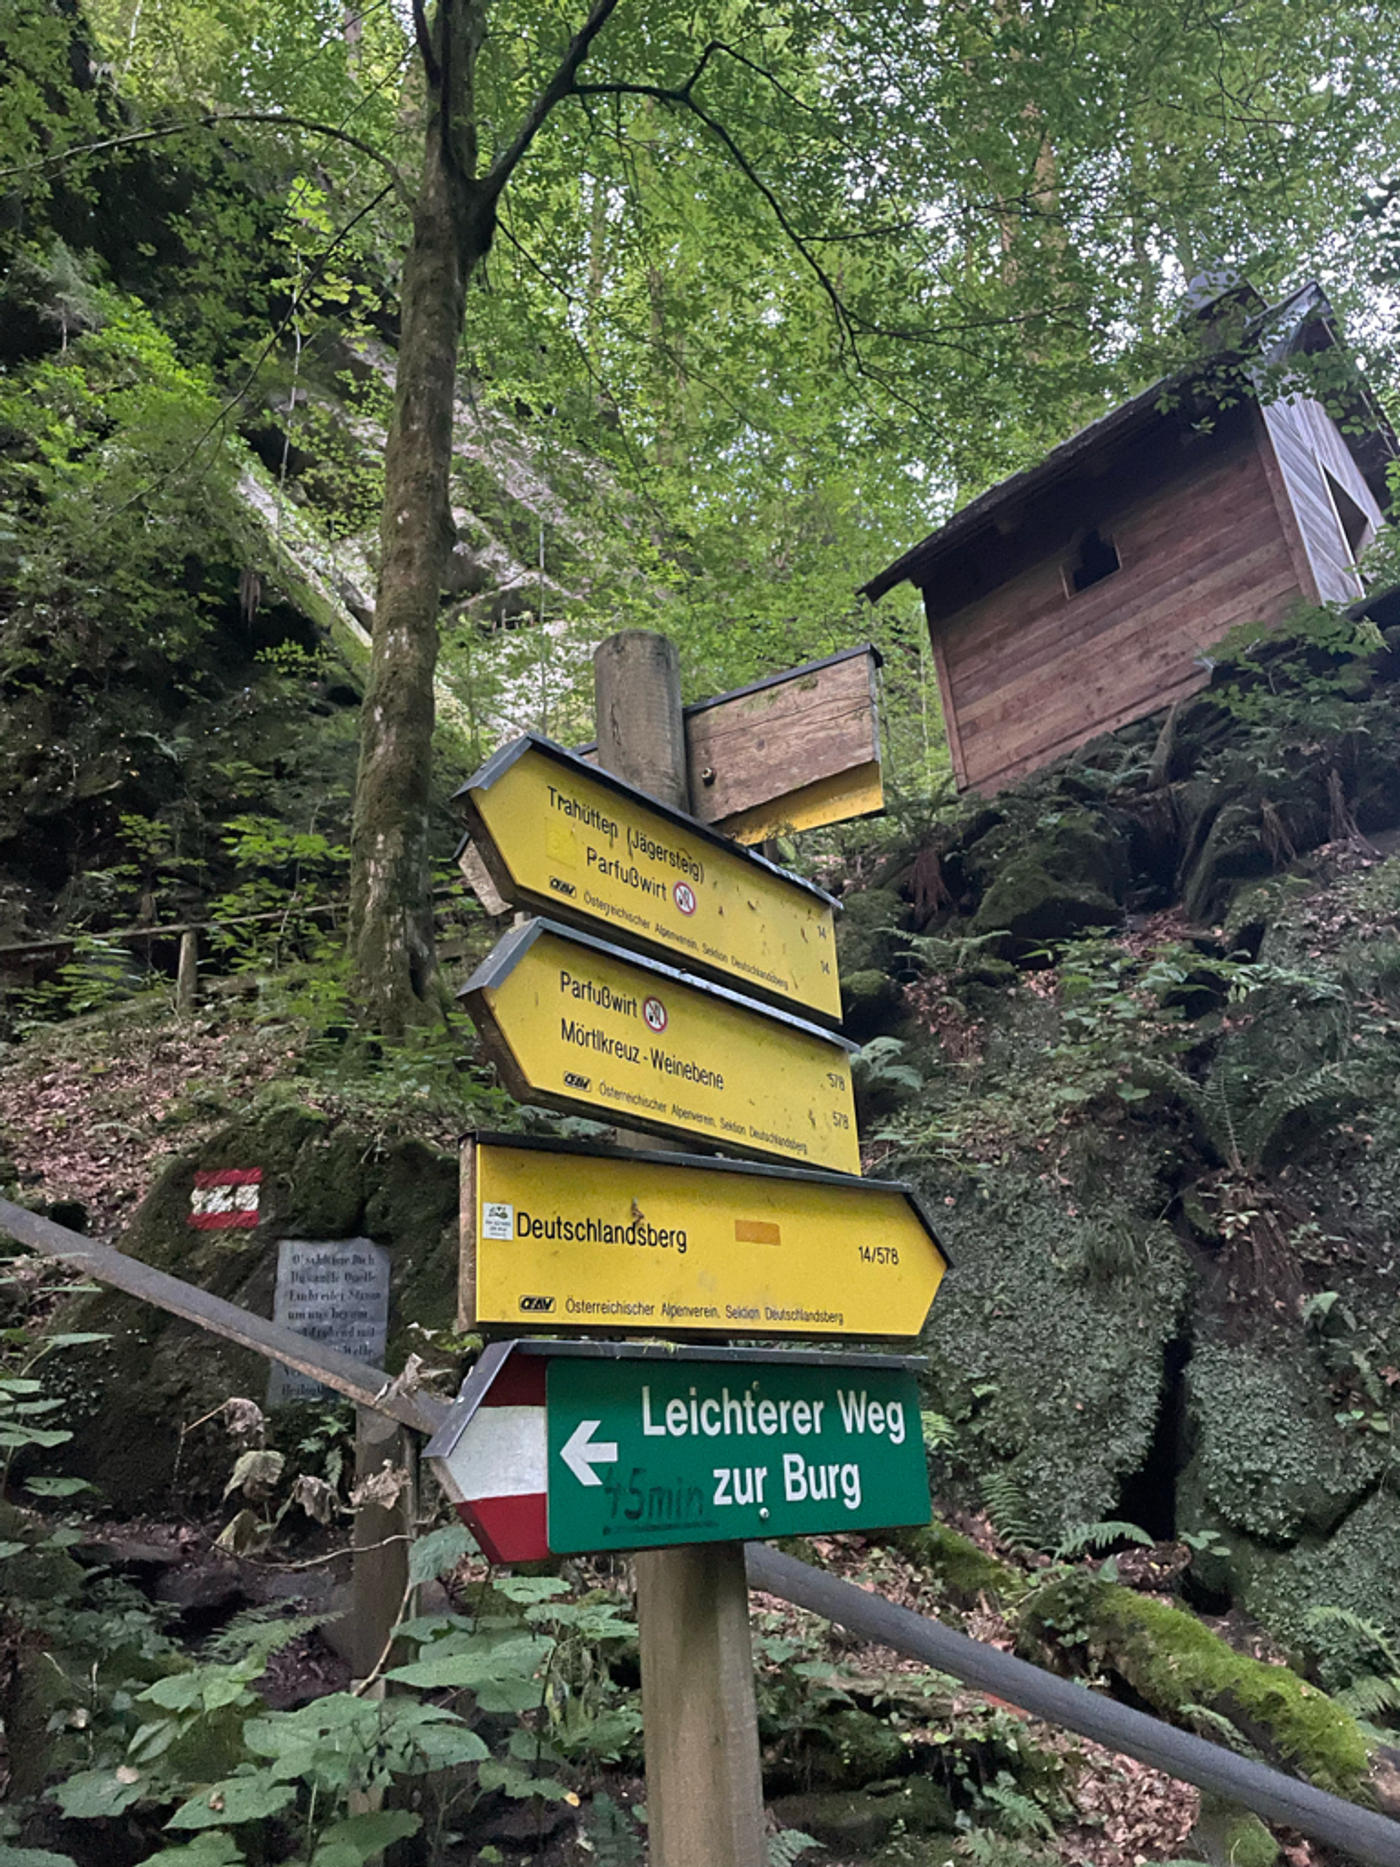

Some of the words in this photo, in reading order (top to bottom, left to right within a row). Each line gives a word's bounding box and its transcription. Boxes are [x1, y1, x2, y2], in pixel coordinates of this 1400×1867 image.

[547, 785, 618, 839] Trahütten
[626, 826, 705, 884] (Jägersteig)
[587, 847, 667, 900] Parfußwirt
[560, 970, 638, 1018] Parfußwirt
[600, 1080, 667, 1113] Österreichischer
[827, 1073, 845, 1091] 578
[832, 1110, 849, 1130] 578
[517, 1212, 687, 1253] Deutschlandsberg
[858, 1246, 900, 1265] 14/578
[566, 1298, 655, 1316] Österreichischer
[725, 1305, 760, 1321] Sektion
[765, 1307, 844, 1326] Deutschlandsberg
[642, 1385, 824, 1437] Leichterer
[837, 1390, 906, 1445] Weg
[713, 1466, 767, 1506] zur
[783, 1453, 862, 1510] Burg
